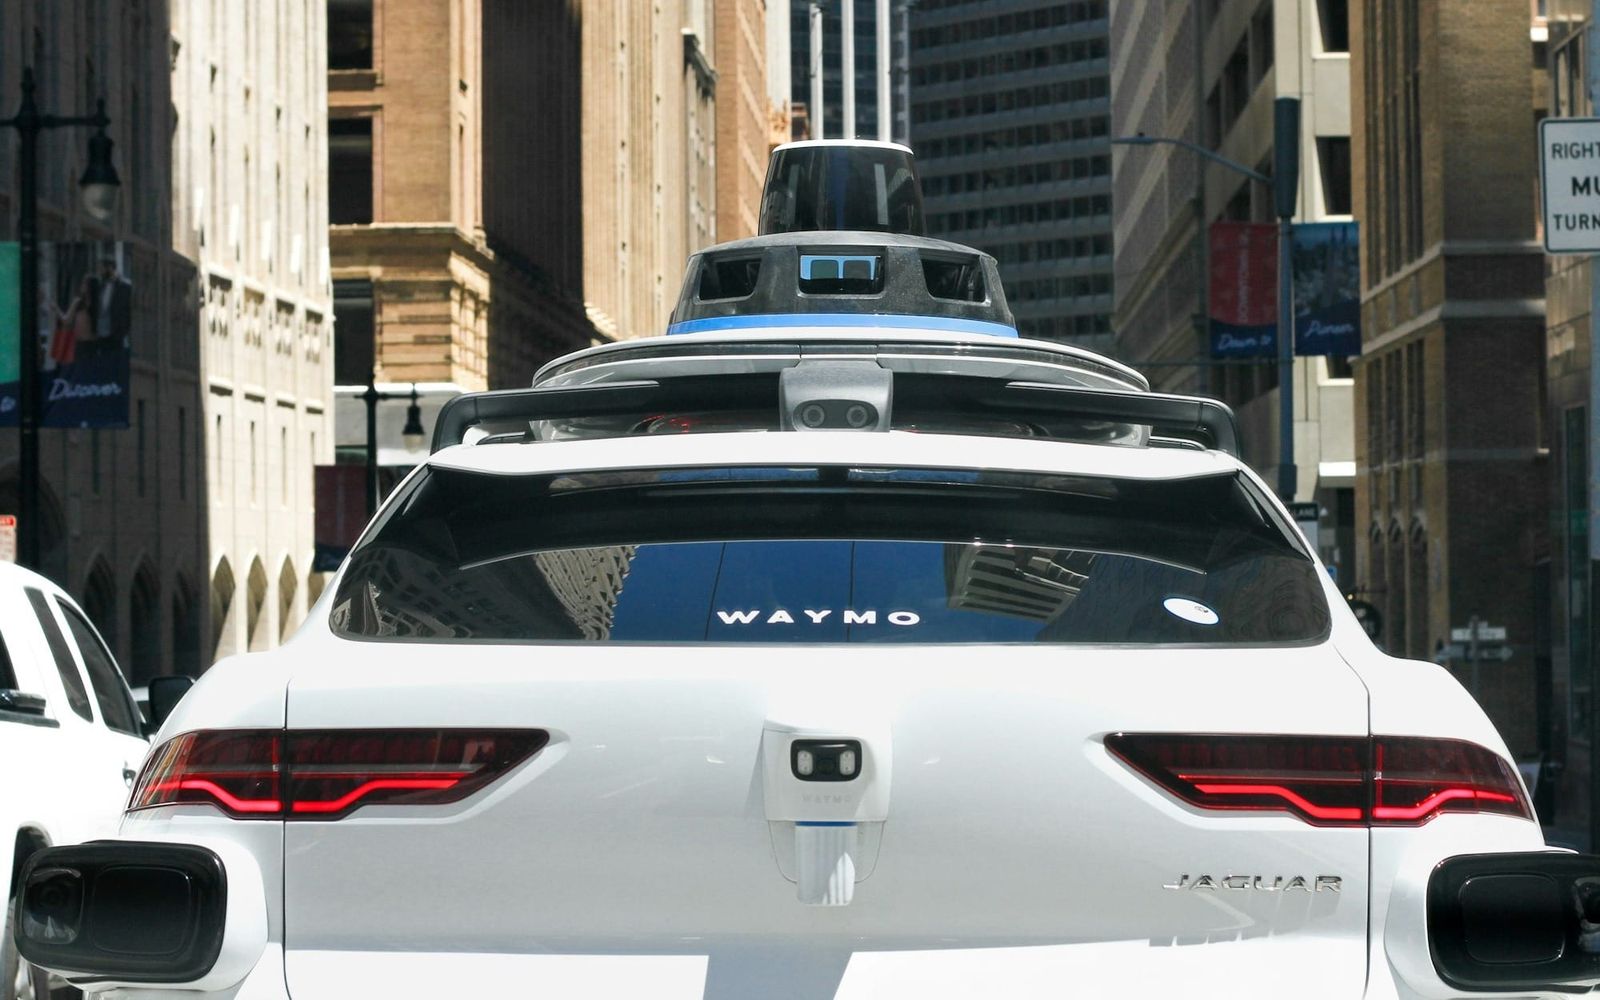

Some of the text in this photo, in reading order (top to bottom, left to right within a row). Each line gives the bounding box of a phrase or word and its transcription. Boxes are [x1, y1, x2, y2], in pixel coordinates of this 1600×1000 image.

[49, 378, 122, 401] Discover
[716, 609, 921, 626] WAYMO
[1162, 874, 1343, 893] JAGUAR
